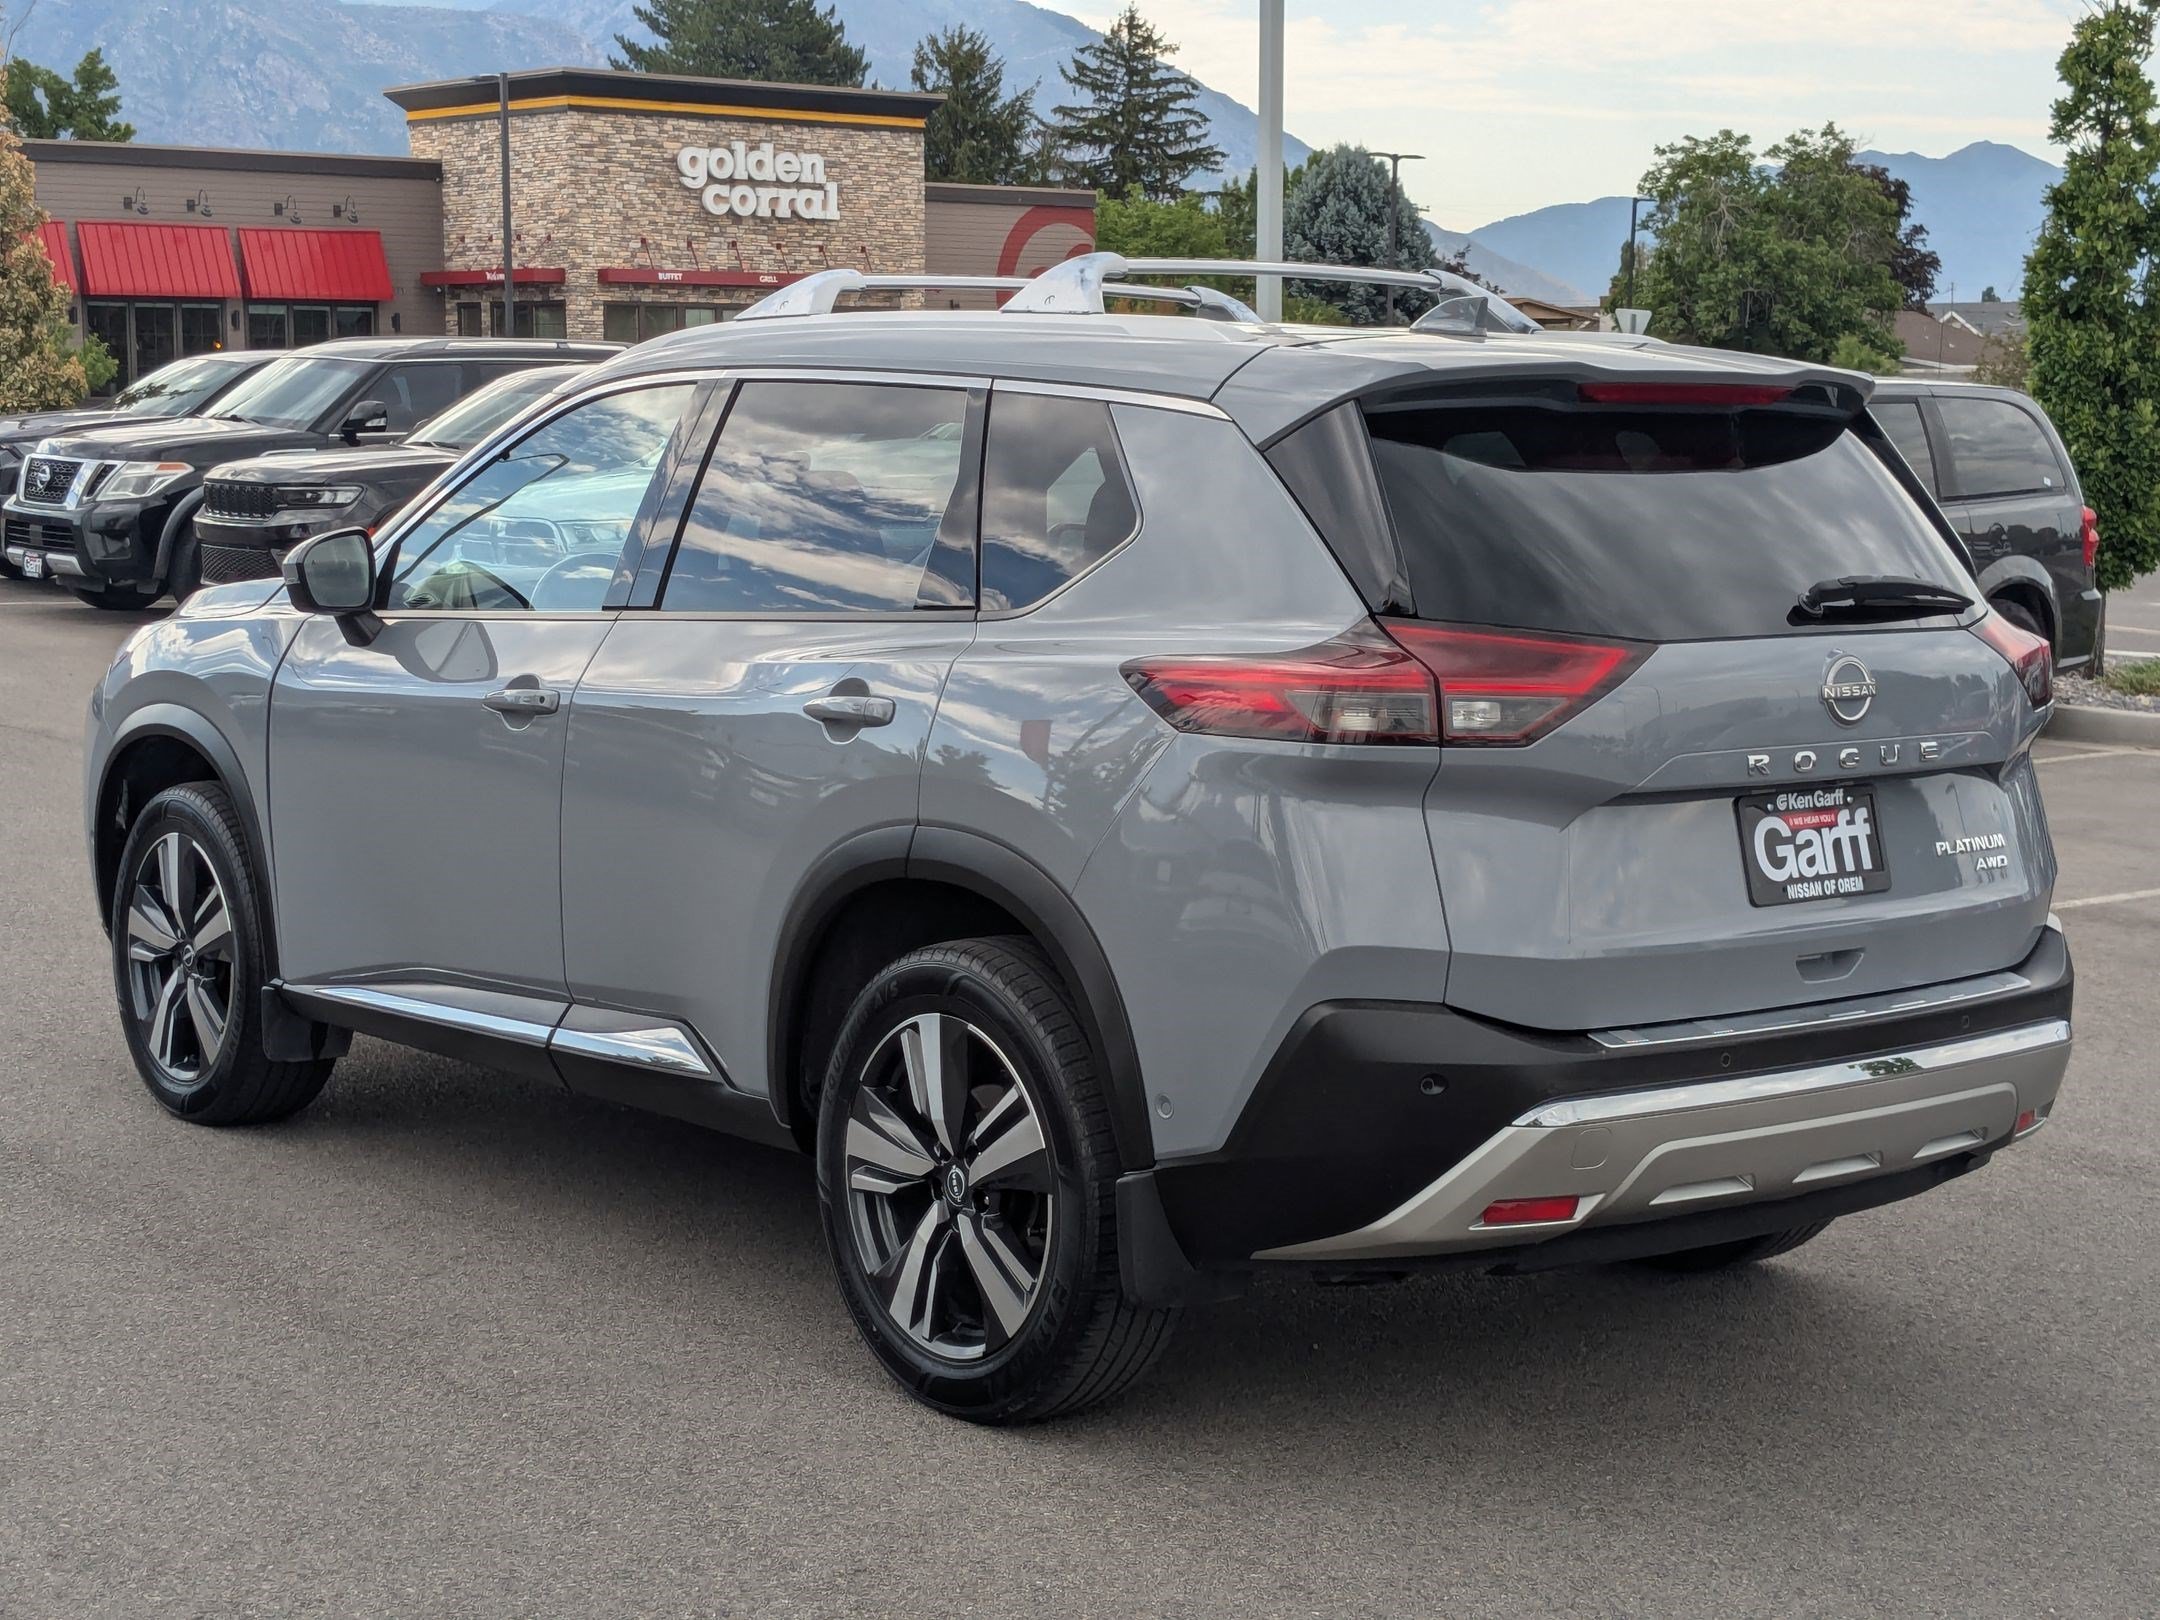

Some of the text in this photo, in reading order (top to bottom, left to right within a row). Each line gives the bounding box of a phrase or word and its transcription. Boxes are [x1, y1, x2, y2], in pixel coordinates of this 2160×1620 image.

[677, 141, 826, 189] golden
[702, 182, 840, 220] corral
[658, 273, 683, 281] BUFFET
[759, 275, 778, 283] GRILL
[1824, 685, 1876, 698] NISSAN
[1747, 741, 1940, 776] ROGUE
[1788, 792, 1813, 810] Ken
[1814, 788, 1844, 808] Garff
[1754, 807, 1873, 882] Garff
[1935, 833, 2006, 856] PLATINUM
[1976, 855, 2008, 871] AWD
[1787, 876, 1864, 899] NISSAN OF OREM
